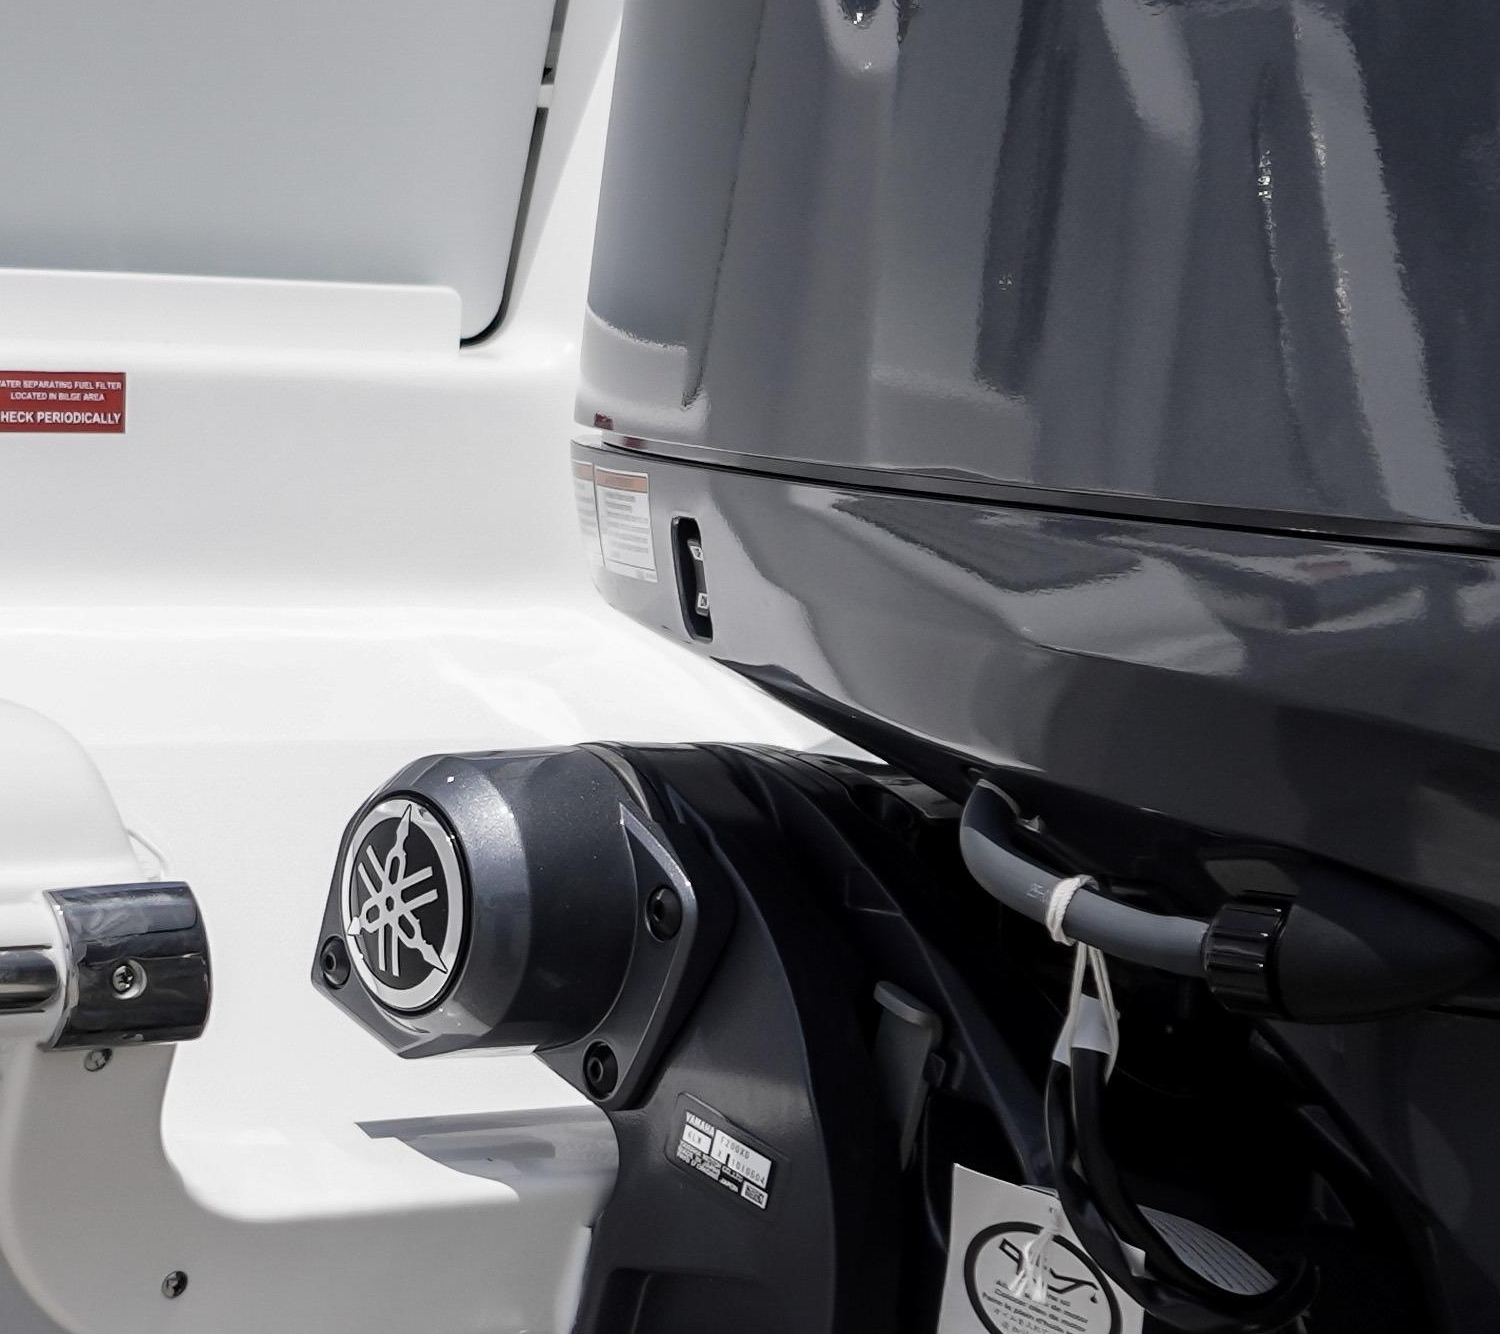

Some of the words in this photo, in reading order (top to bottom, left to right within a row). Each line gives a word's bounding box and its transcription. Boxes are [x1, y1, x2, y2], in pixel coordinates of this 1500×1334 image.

[23, 380, 72, 390] SEPARATING
[74, 381, 94, 390] FUEL
[95, 381, 122, 390] FILTER
[10, 392, 47, 401] LOCATED
[48, 392, 57, 401] IN
[58, 393, 81, 401] BILGE
[83, 393, 105, 402] AREA
[37, 411, 122, 424] PERIODICALLY
